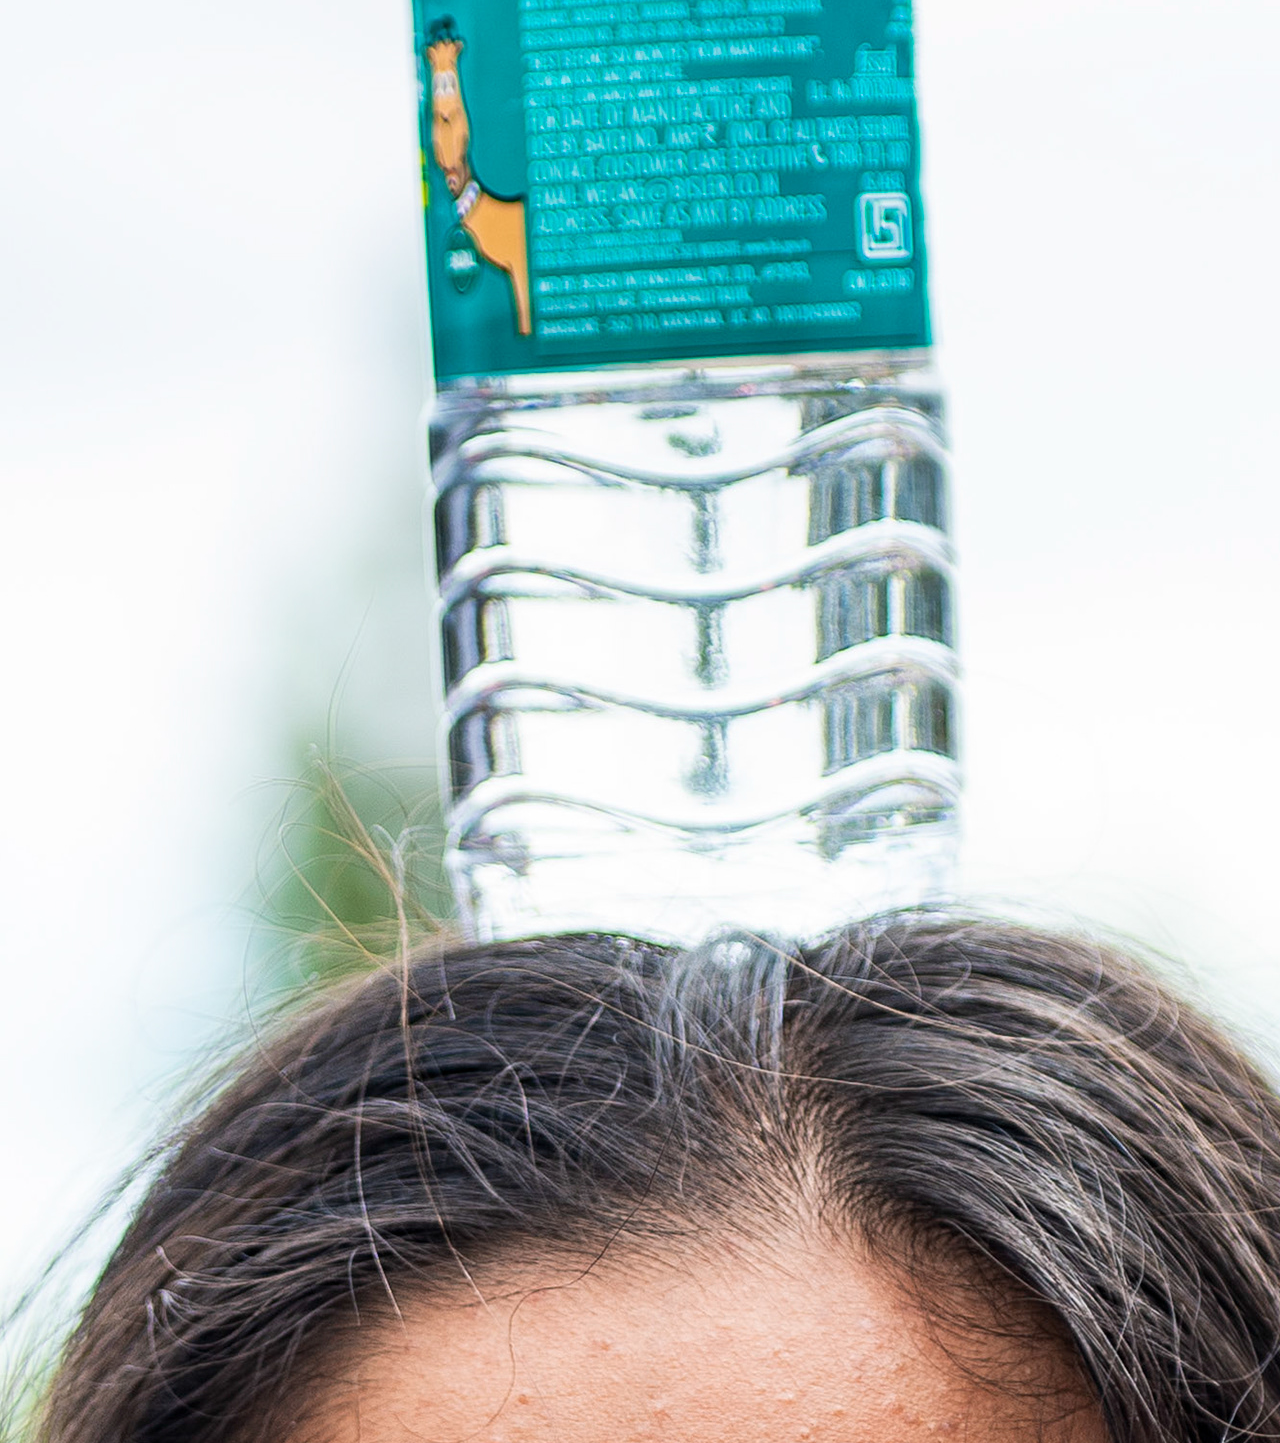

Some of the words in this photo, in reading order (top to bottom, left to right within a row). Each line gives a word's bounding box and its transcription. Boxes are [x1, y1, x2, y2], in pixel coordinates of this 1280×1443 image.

[560, 104, 599, 128] DATE
[599, 102, 624, 126] OF
[624, 95, 753, 124] MANUFACTURE
[754, 93, 792, 117] AND
[599, 151, 687, 178] CUSTOMER
